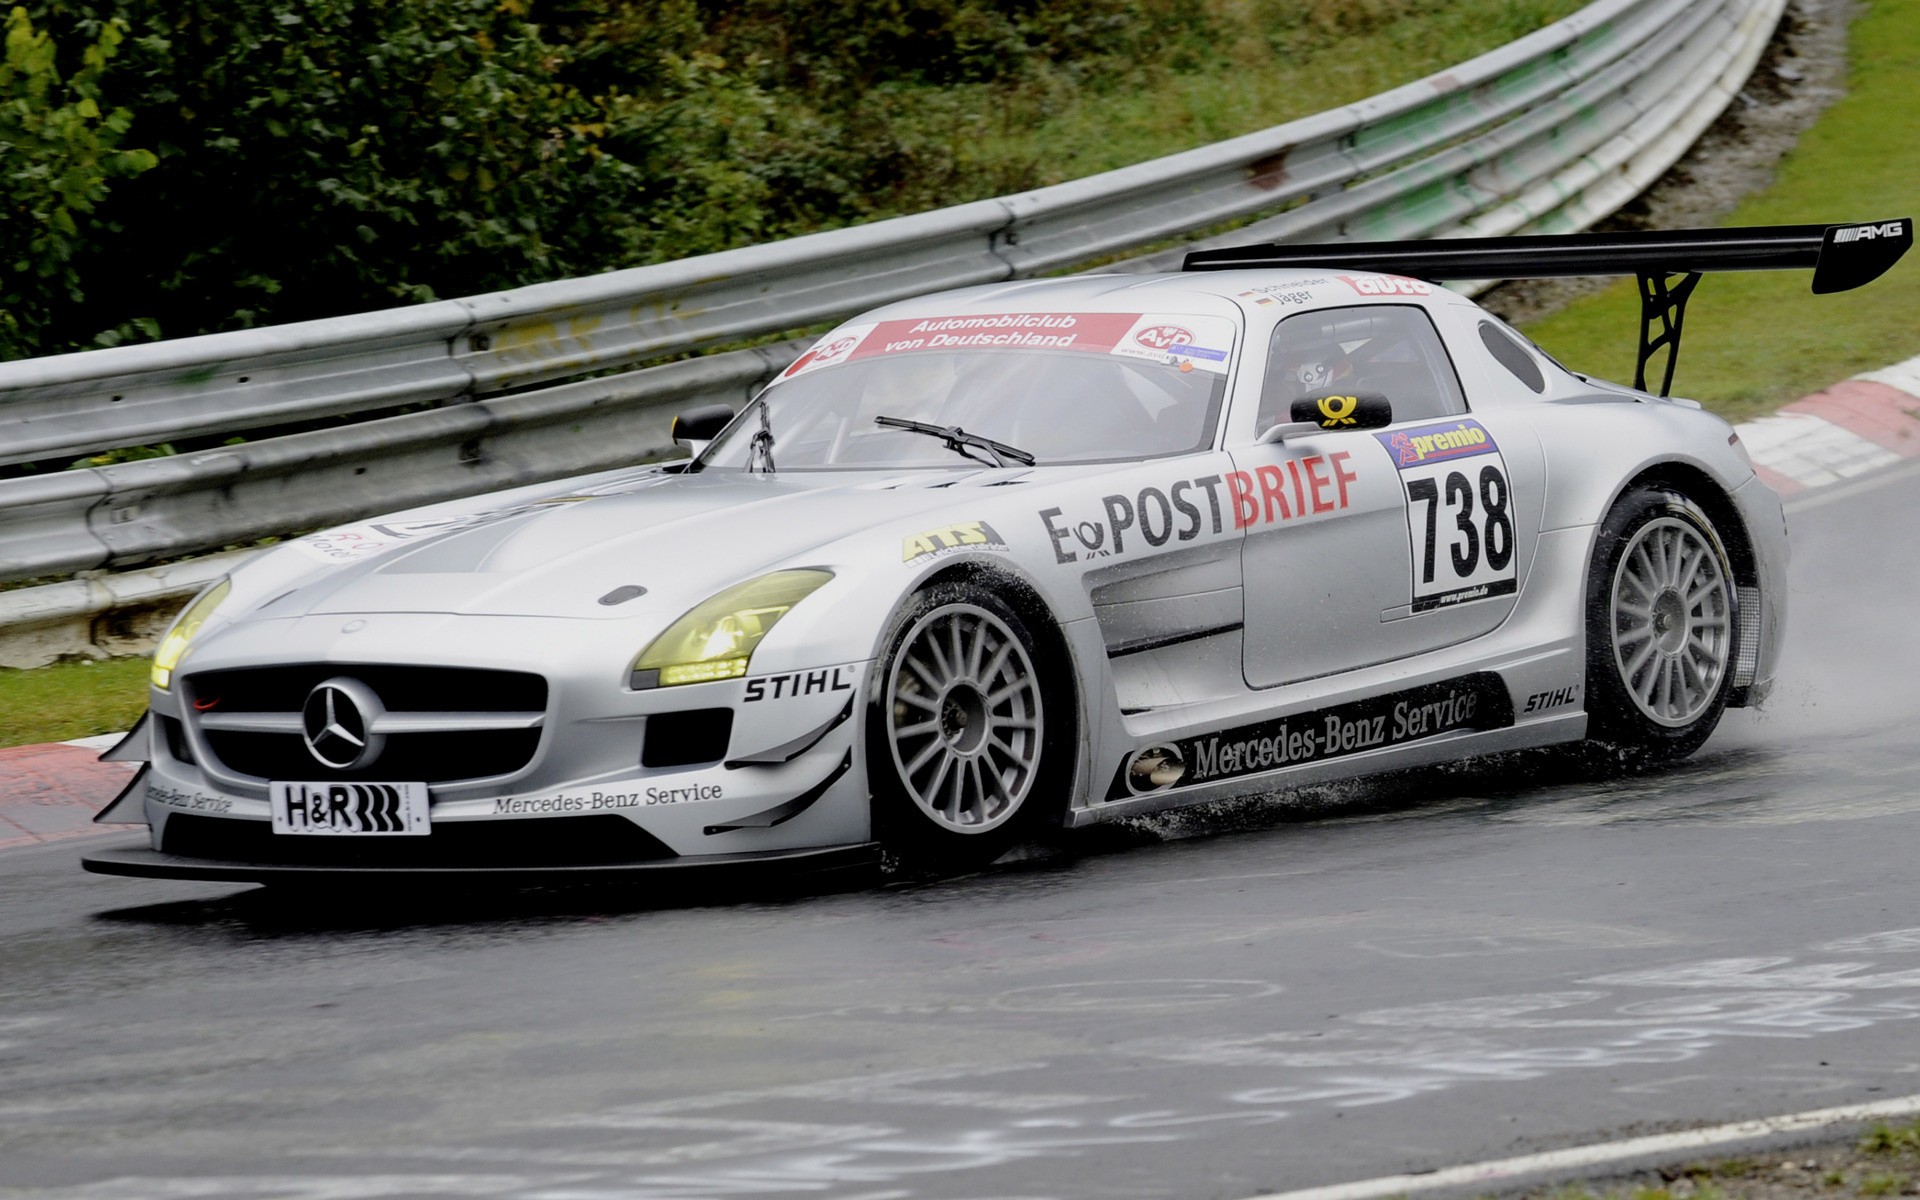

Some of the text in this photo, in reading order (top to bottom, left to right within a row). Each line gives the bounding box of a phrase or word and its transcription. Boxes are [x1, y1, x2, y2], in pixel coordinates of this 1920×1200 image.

[1855, 222, 1902, 240] AMG
[1251, 278, 1329, 294] Schneider
[1355, 276, 1432, 294] auto
[1270, 290, 1313, 305] Jäger
[909, 314, 1077, 334] Automobilclub
[885, 331, 1078, 352] von Deutschland
[1137, 328, 1192, 348] AvD
[1410, 424, 1486, 460] premio
[1406, 465, 1513, 584] 738
[903, 520, 987, 562] ATS
[1440, 585, 1489, 604] www.premio.de
[743, 668, 851, 702] STIHL
[1523, 687, 1575, 714] STIHL
[1194, 689, 1478, 779] Mercedes-Benz Service
[285, 783, 357, 831] H&R
[492, 783, 723, 815] Mercedes-Benz Service
